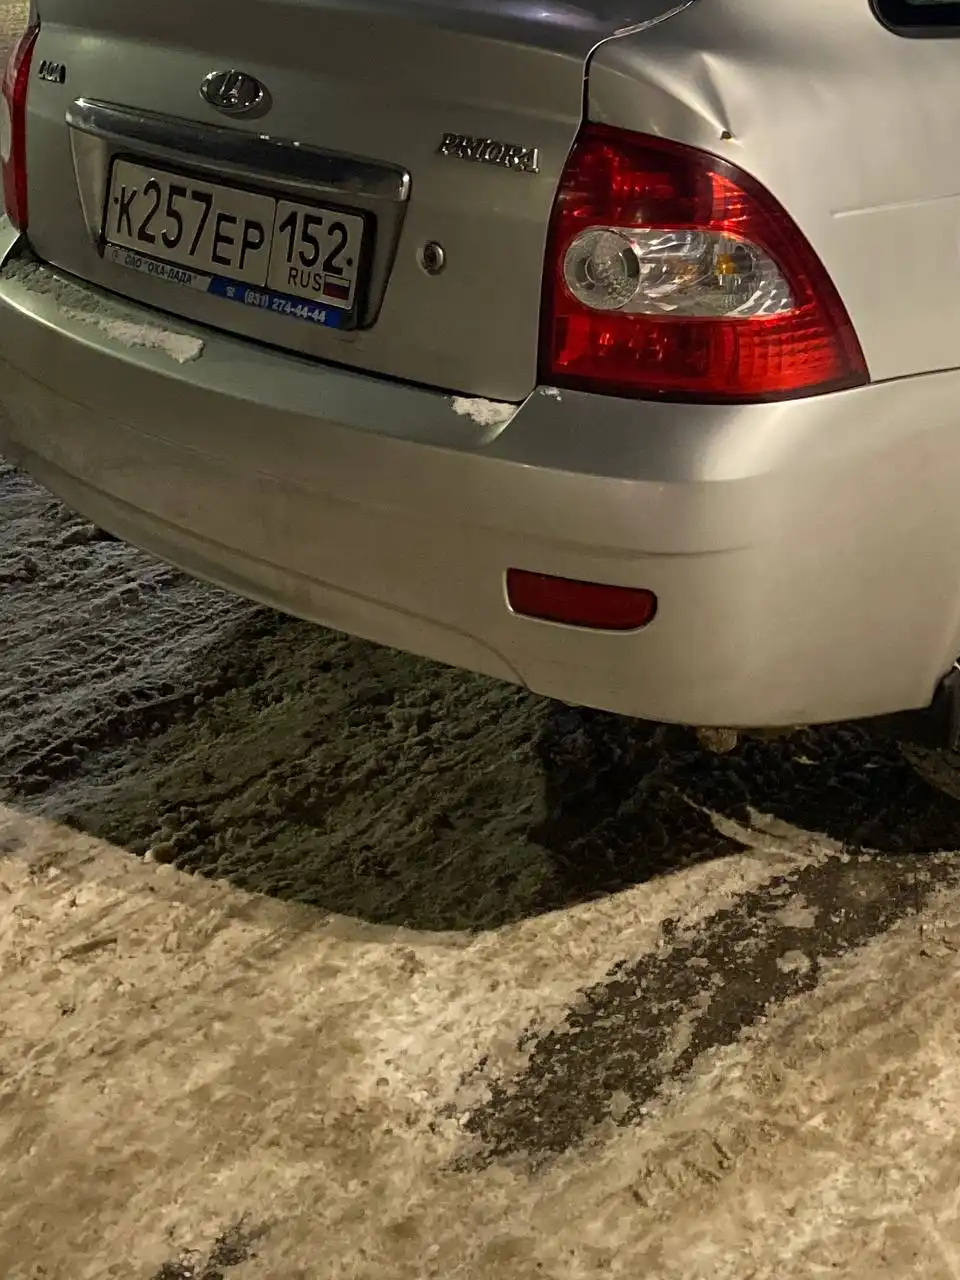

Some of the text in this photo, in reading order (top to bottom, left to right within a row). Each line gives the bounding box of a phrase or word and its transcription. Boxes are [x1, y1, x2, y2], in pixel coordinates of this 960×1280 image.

[437, 131, 541, 174] PRIORA
[279, 210, 349, 275] 152
[287, 267, 322, 292] RUS
[272, 297, 326, 323] 274-44-44
